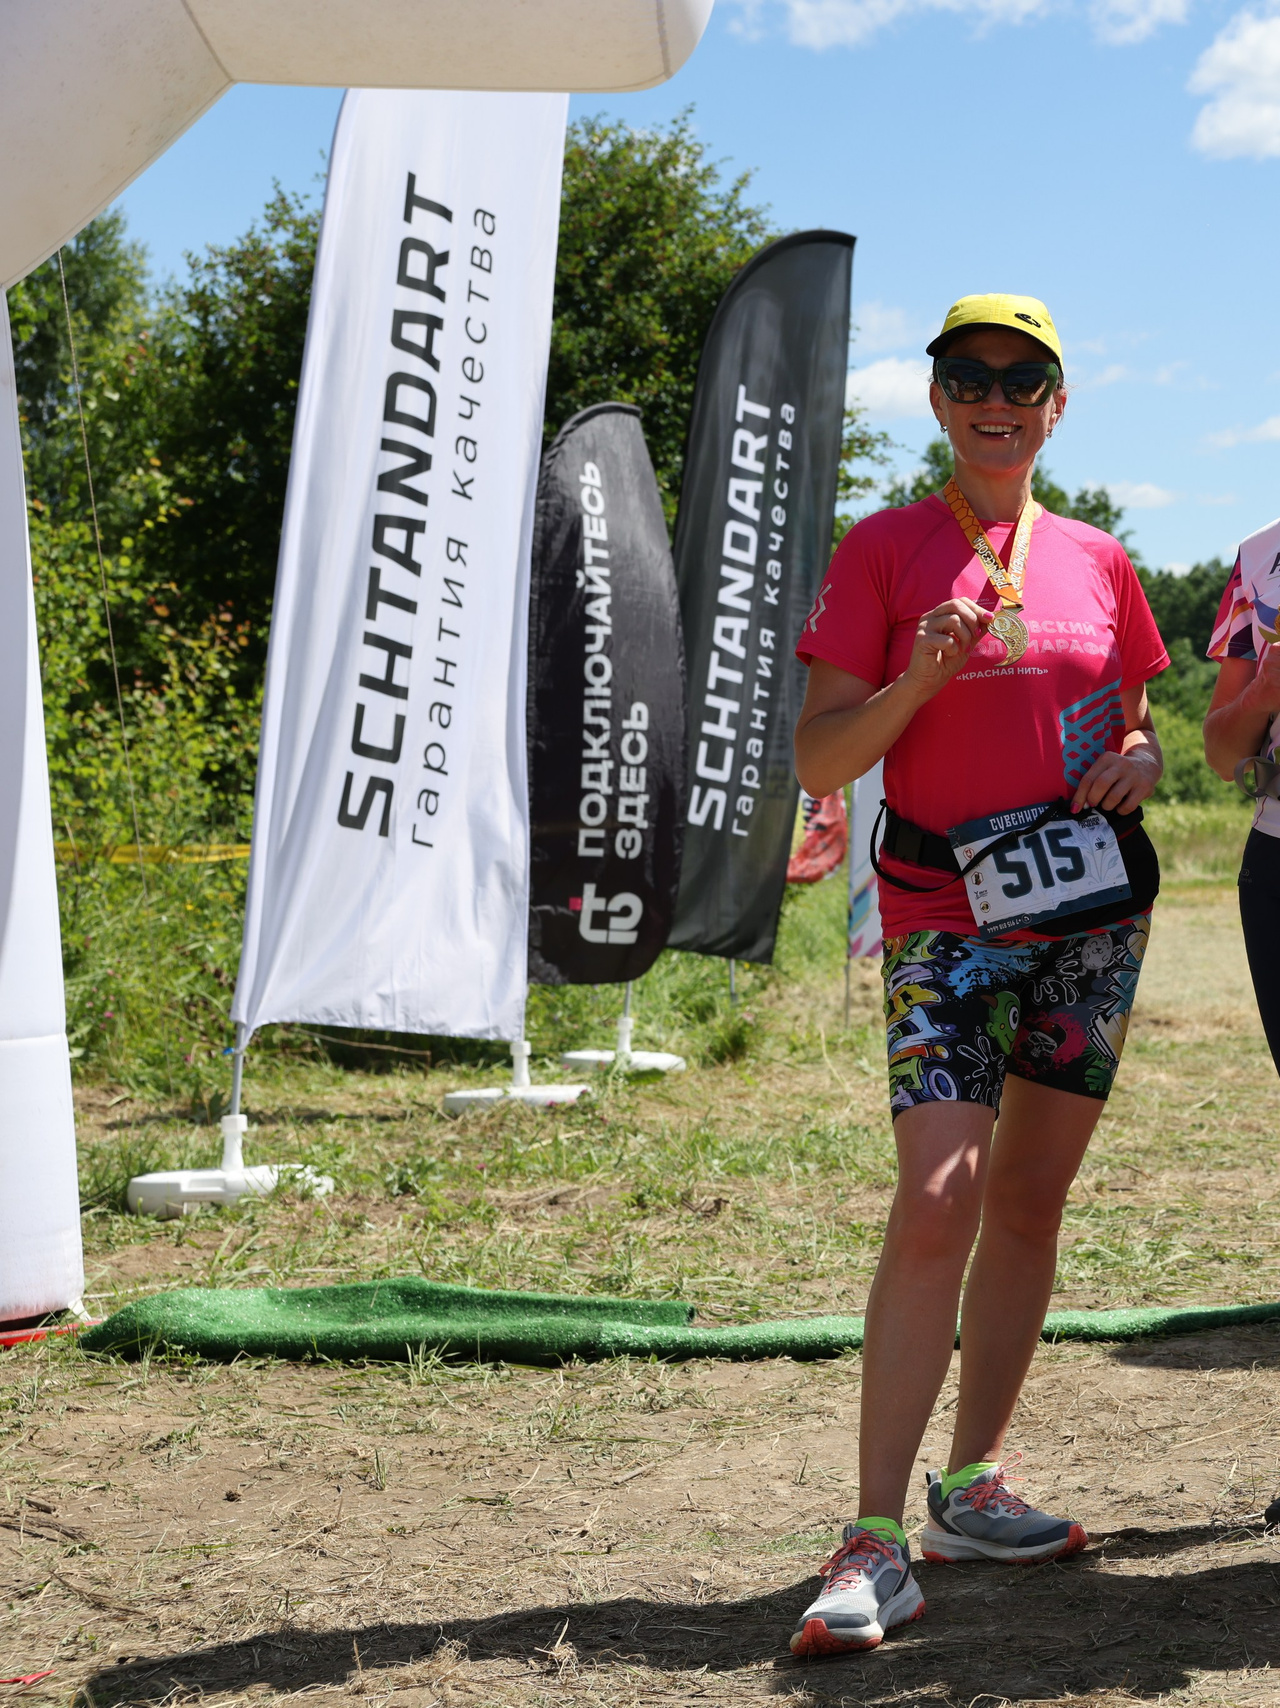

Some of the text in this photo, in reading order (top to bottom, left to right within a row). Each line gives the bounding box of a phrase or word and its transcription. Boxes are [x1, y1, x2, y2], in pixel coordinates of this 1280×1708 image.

[337, 170, 454, 838] SCHTANDART
[411, 207, 497, 849] гарантия качества
[687, 384, 771, 831] SCHTANDART
[732, 628, 776, 837] гарантия
[763, 402, 796, 606] качества
[972, 534, 997, 569] СЕЗОНА
[1028, 620, 1097, 637] ВСКИЙ
[575, 460, 614, 858] ПОДКЛЮЧАЙТЕСЬ
[614, 701, 650, 859] ЗДЕСЬ
[956, 667, 1049, 681] «КРАСНАЯ НИТЬ»
[991, 827, 1086, 899] 515
